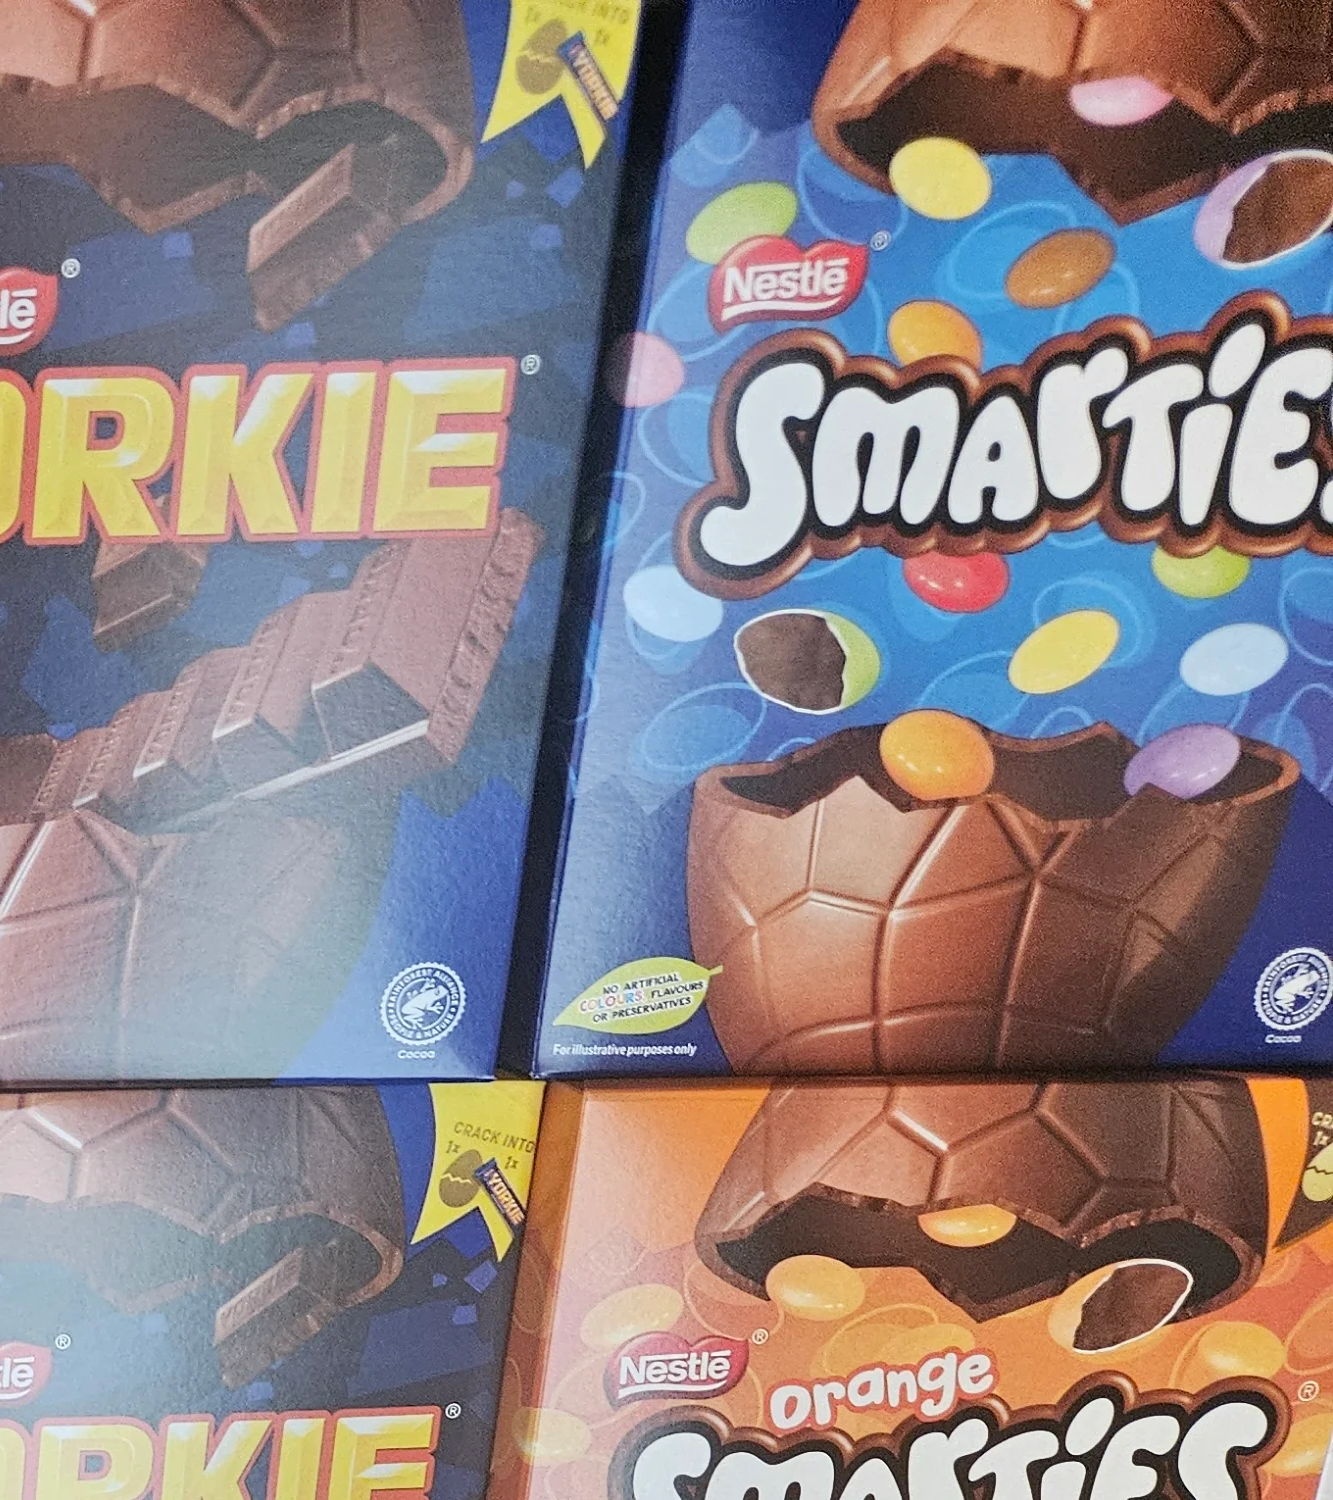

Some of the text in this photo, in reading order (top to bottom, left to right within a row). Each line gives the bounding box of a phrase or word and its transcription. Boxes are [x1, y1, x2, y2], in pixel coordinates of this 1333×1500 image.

[700, 322, 1333, 567] SMARTIE
[580, 981, 704, 1012] COLOURS FLAVOURS
[603, 973, 679, 996] NO ARTIFICIAL
[593, 997, 692, 1023] OR PRESERVATIVES
[553, 1042, 697, 1057] For illustrative purposes only
[445, 1140, 461, 1154] 1x
[454, 1121, 535, 1153] CRACK INTO
[504, 1156, 520, 1170] 1x
[487, 1169, 526, 1226] YORKIE
